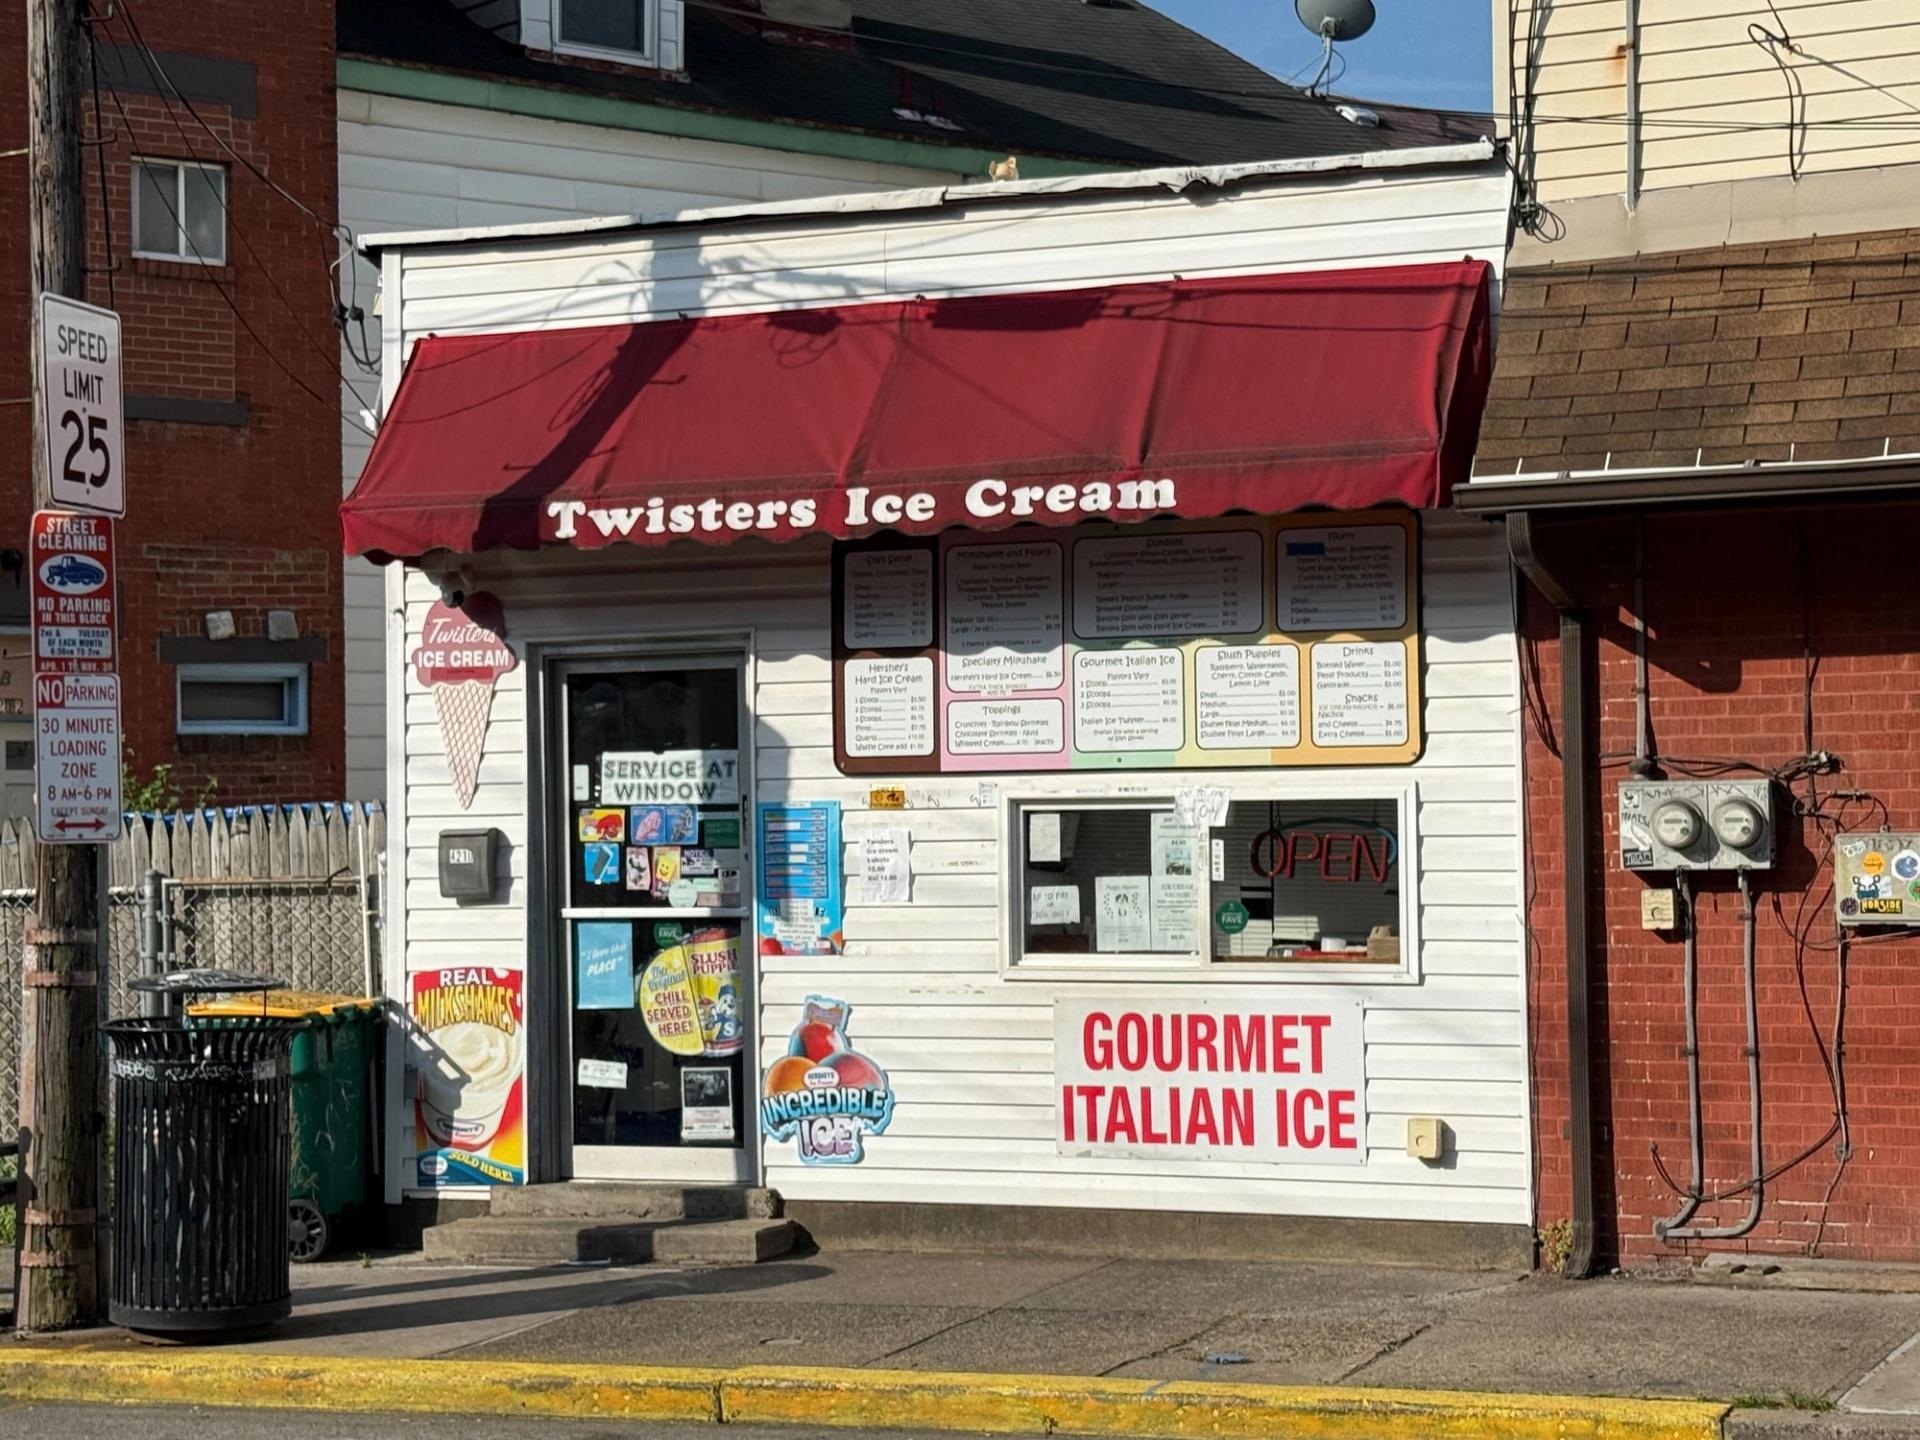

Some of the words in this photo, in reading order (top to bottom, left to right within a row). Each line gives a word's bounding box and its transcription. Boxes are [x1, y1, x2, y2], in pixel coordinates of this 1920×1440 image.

[57, 323, 108, 364] SPEED
[63, 367, 104, 405] LIMIT
[60, 409, 111, 488] 25
[546, 496, 818, 540] Twisters
[844, 486, 937, 526] Ice
[965, 477, 1177, 519] Cream
[47, 517, 97, 535] STREET
[39, 533, 107, 551] CLEANING
[39, 597, 54, 612] NO
[60, 598, 111, 614] PARKING
[42, 612, 53, 624] IN
[56, 612, 76, 623] THIS
[80, 613, 107, 625] BLOCK
[79, 630, 109, 638] TUESDAY
[428, 617, 497, 645] Twisters
[48, 639, 56, 647] OF
[59, 639, 77, 648] EACH
[80, 640, 103, 649] MONTH
[1342, 647, 1375, 658] Drinks
[417, 650, 446, 669] ICE
[450, 649, 510, 669] CREAM
[961, 656, 1002, 668] Specialty
[1003, 655, 1048, 668] Milkshake
[1080, 657, 1124, 669] Gourmet
[1125, 656, 1157, 667] Italian
[1159, 655, 1176, 666] Ice
[1217, 650, 1243, 661] Slush
[1244, 649, 1281, 660] Puppies
[868, 663, 909, 674] Hershey's
[855, 675, 877, 685] Hard
[879, 674, 893, 685] Ice
[894, 674, 924, 685] Cream
[1107, 673, 1132, 682] Flavors
[38, 679, 64, 704] NO
[66, 685, 116, 702] PARKING
[1344, 693, 1378, 705] Snacks
[982, 704, 1022, 716] Toppings
[42, 718, 59, 734] 30
[66, 718, 114, 735] MINUTE
[51, 740, 107, 757] LOADING
[61, 762, 97, 778] ZONE
[603, 760, 698, 779] SERVICE
[706, 760, 738, 778] AT
[48, 785, 56, 801] 8
[97, 787, 112, 801] PM
[614, 781, 717, 801] WINDOW
[51, 807, 79, 817] EXCEPT
[81, 807, 108, 817] SUNDAY
[1250, 830, 1389, 885] OPEN
[1861, 899, 1902, 913] NORSIDE
[1221, 915, 1243, 925] FAVE
[690, 948, 737, 966] SLUSH
[693, 960, 738, 977] PUPPIE
[439, 968, 494, 987] REAL
[655, 990, 689, 1006] CHILL
[416, 984, 516, 1037] MILKSHAKES
[647, 1004, 692, 1023] SERVED
[658, 1020, 695, 1038] HERE!
[1083, 1011, 1332, 1074] GOURMET
[762, 1087, 888, 1124] INCREDIBLE
[1062, 1084, 1256, 1147] ITALIAN
[1275, 1088, 1359, 1149] ICE
[801, 1117, 857, 1158] ICE
[447, 1150, 481, 1168] SOLD
[478, 1159, 514, 1183] HERE!
